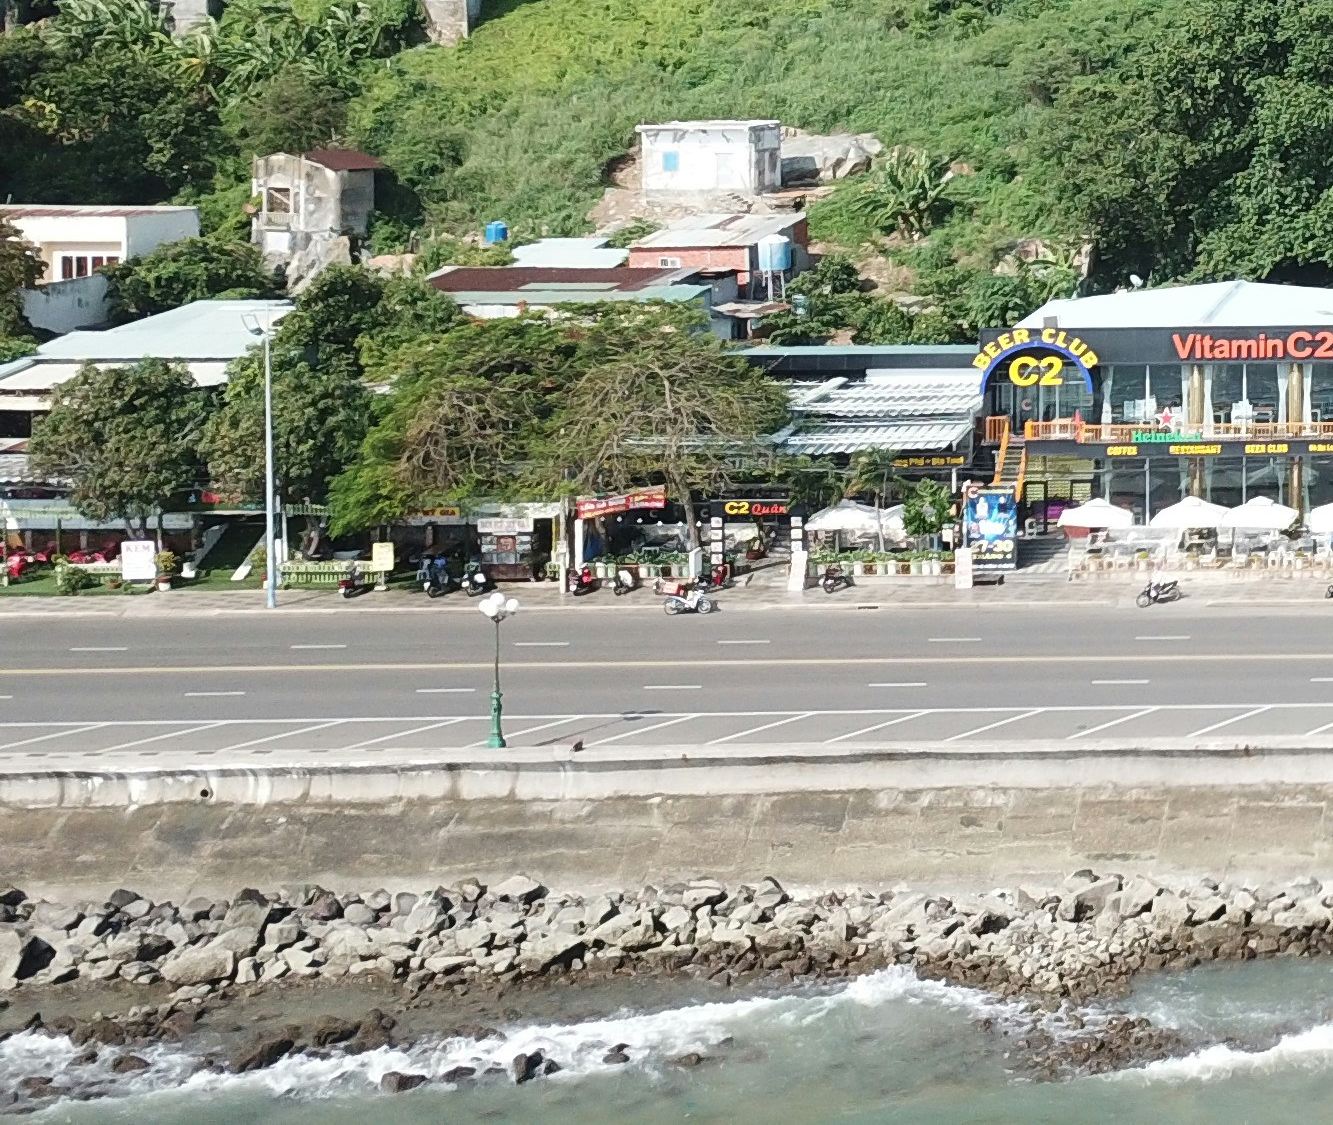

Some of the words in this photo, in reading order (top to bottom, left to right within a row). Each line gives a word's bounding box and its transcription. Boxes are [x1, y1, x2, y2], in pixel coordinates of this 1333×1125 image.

[971, 328, 1030, 371] BEER
[1041, 328, 1099, 369] CLUB
[1008, 355, 1063, 387] C2
[724, 501, 750, 515] C2
[125, 544, 150, 553] KEM
